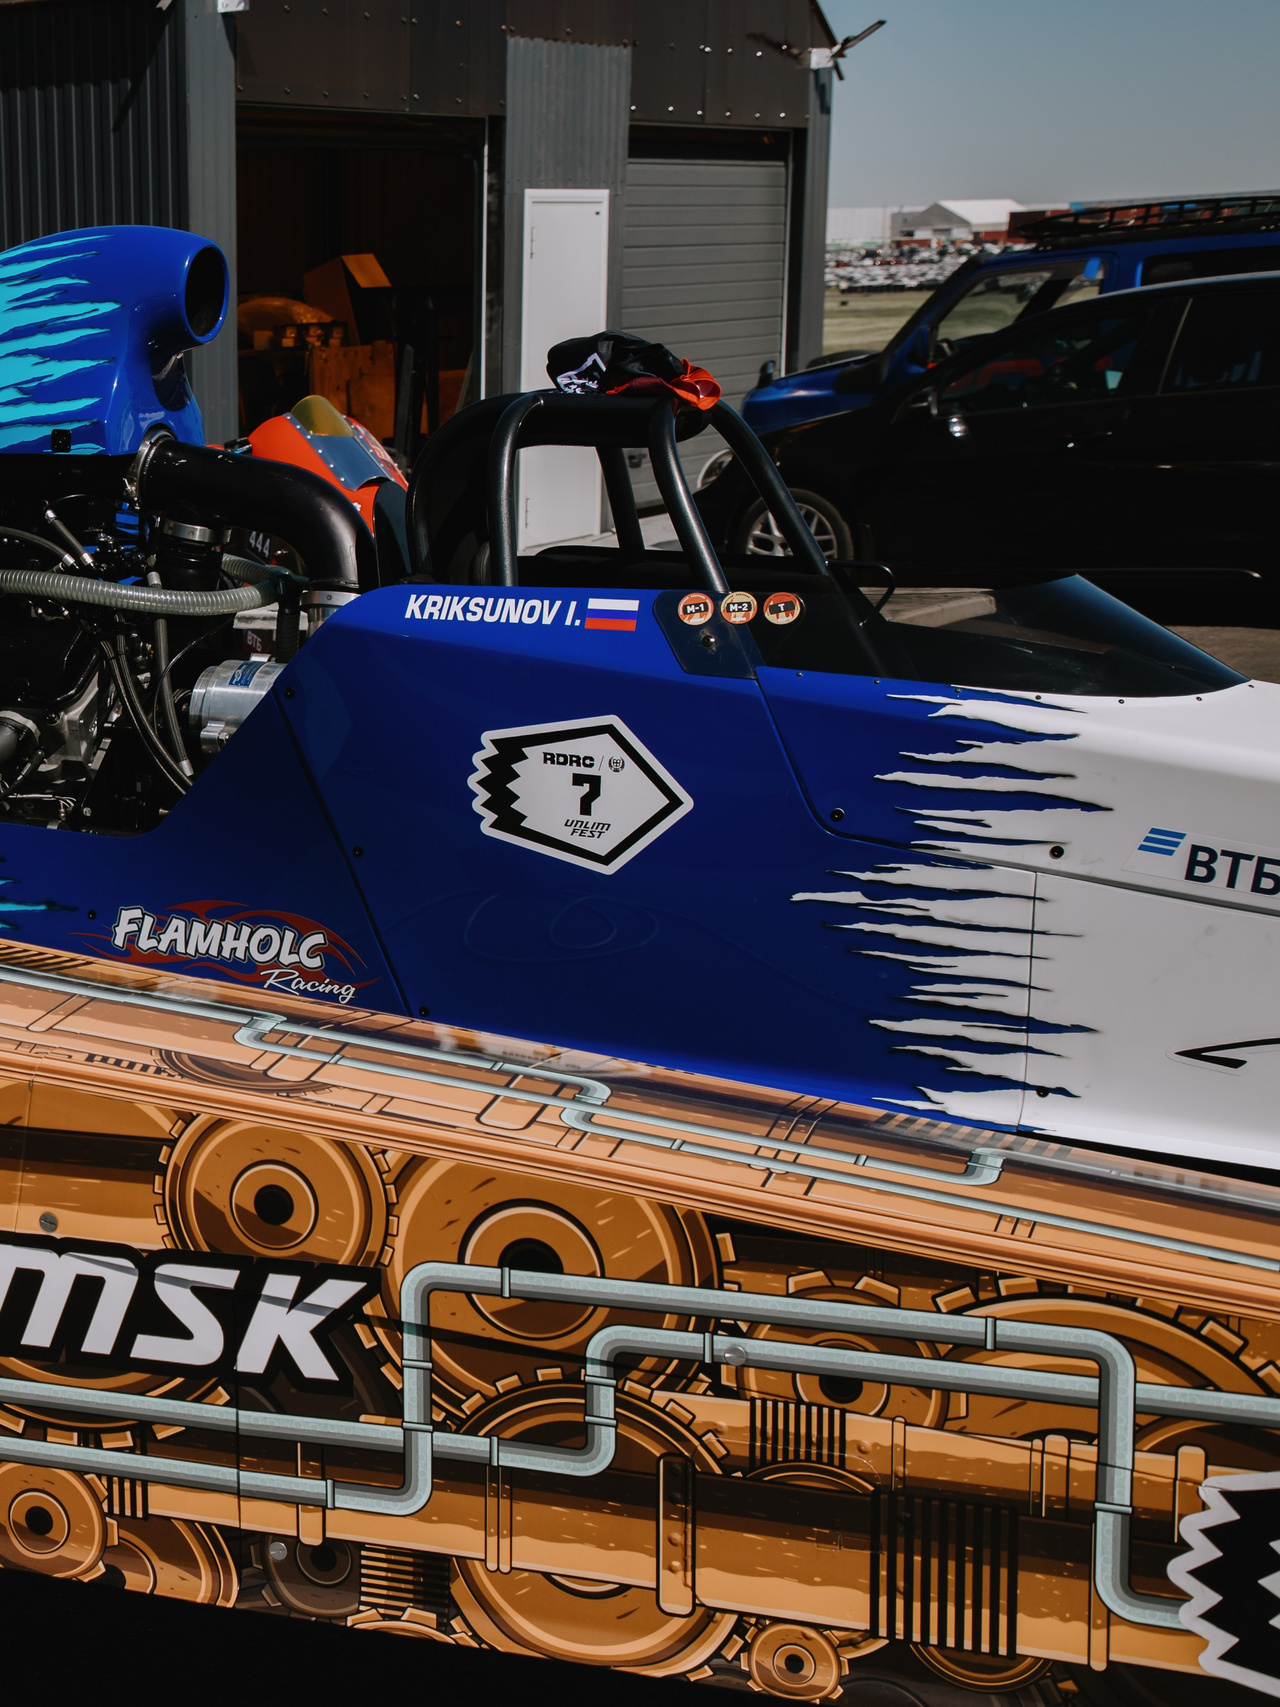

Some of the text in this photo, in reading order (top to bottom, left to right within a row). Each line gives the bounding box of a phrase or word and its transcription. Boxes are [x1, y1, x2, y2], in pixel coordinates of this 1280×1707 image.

[248, 530, 271, 559] 444
[404, 594, 581, 627] KRIKSUNOV I.
[542, 751, 595, 769] RDRC
[571, 773, 602, 817] 7
[564, 819, 612, 832] UNLIM
[570, 828, 606, 840] FEST
[1183, 843, 1280, 897] ВТБ
[112, 905, 327, 970] FLAMHOLC
[259, 968, 358, 1005] Racing
